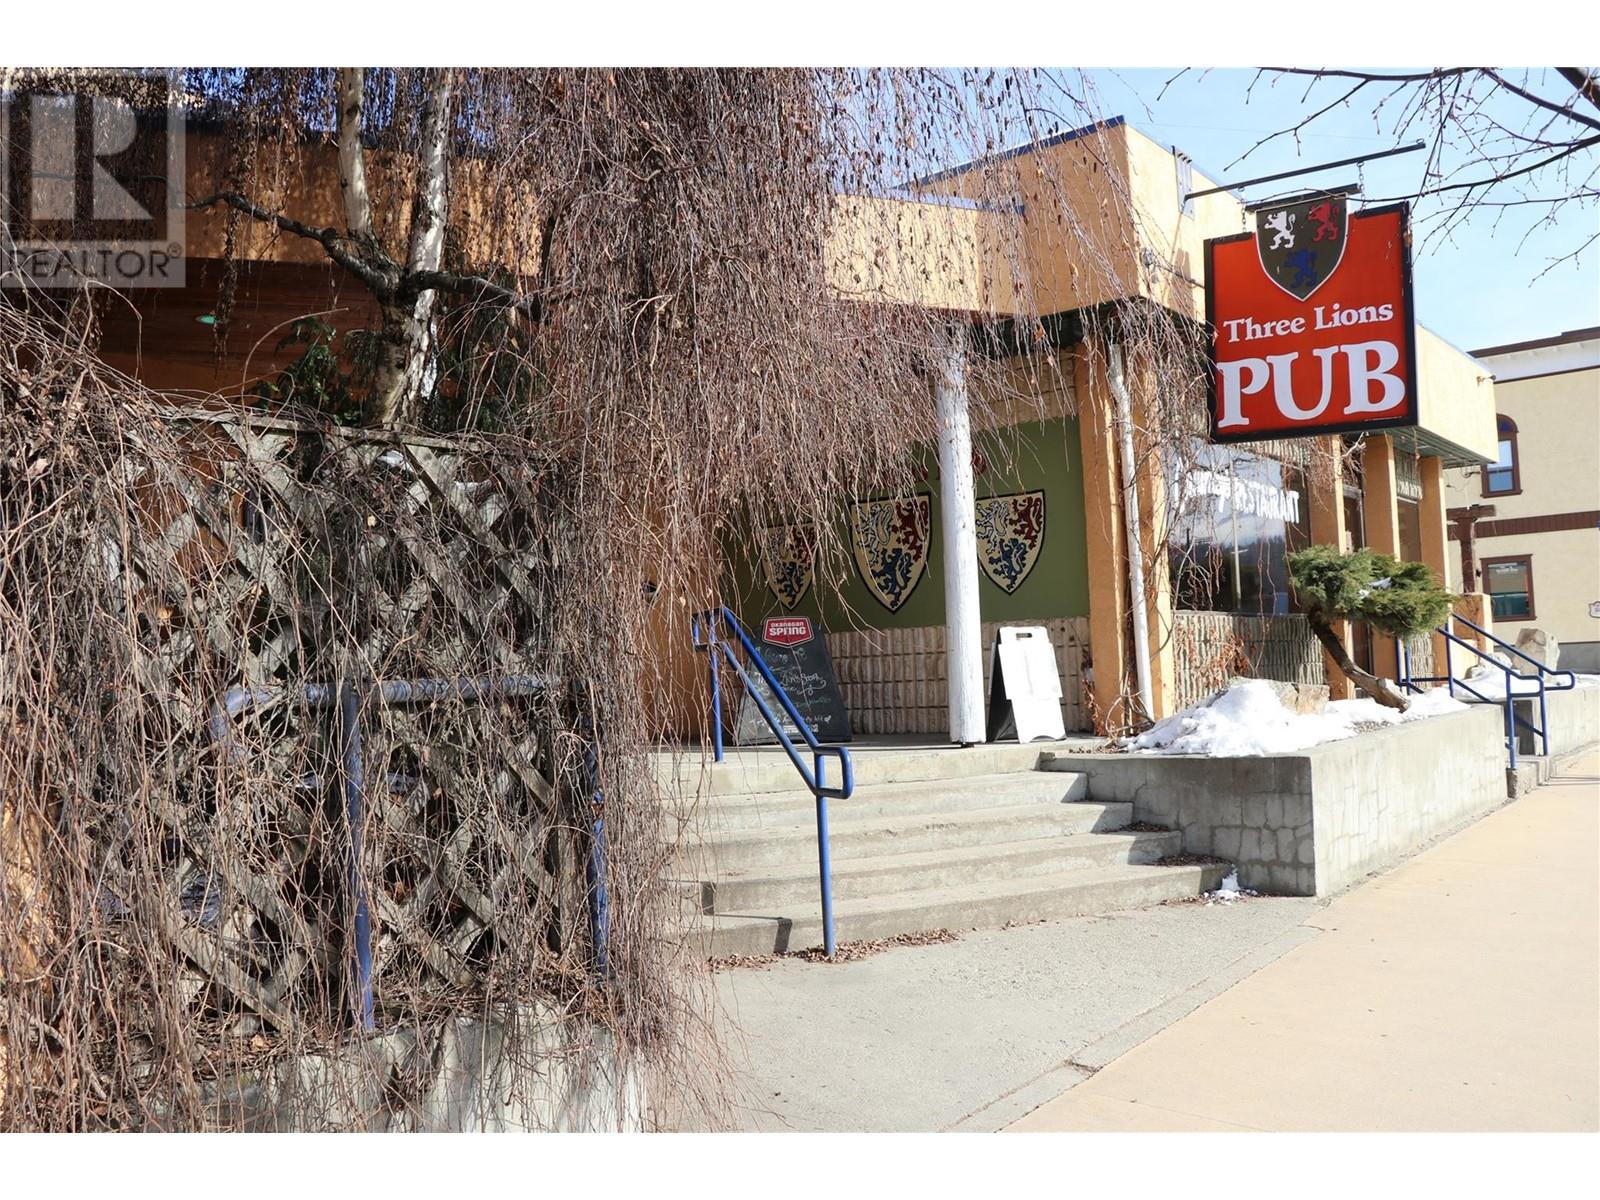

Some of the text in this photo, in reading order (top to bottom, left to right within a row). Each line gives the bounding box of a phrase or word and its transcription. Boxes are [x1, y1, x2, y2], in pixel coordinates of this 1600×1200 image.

[1223, 303, 1394, 343] Three Lions
[1216, 340, 1406, 428] PUB
